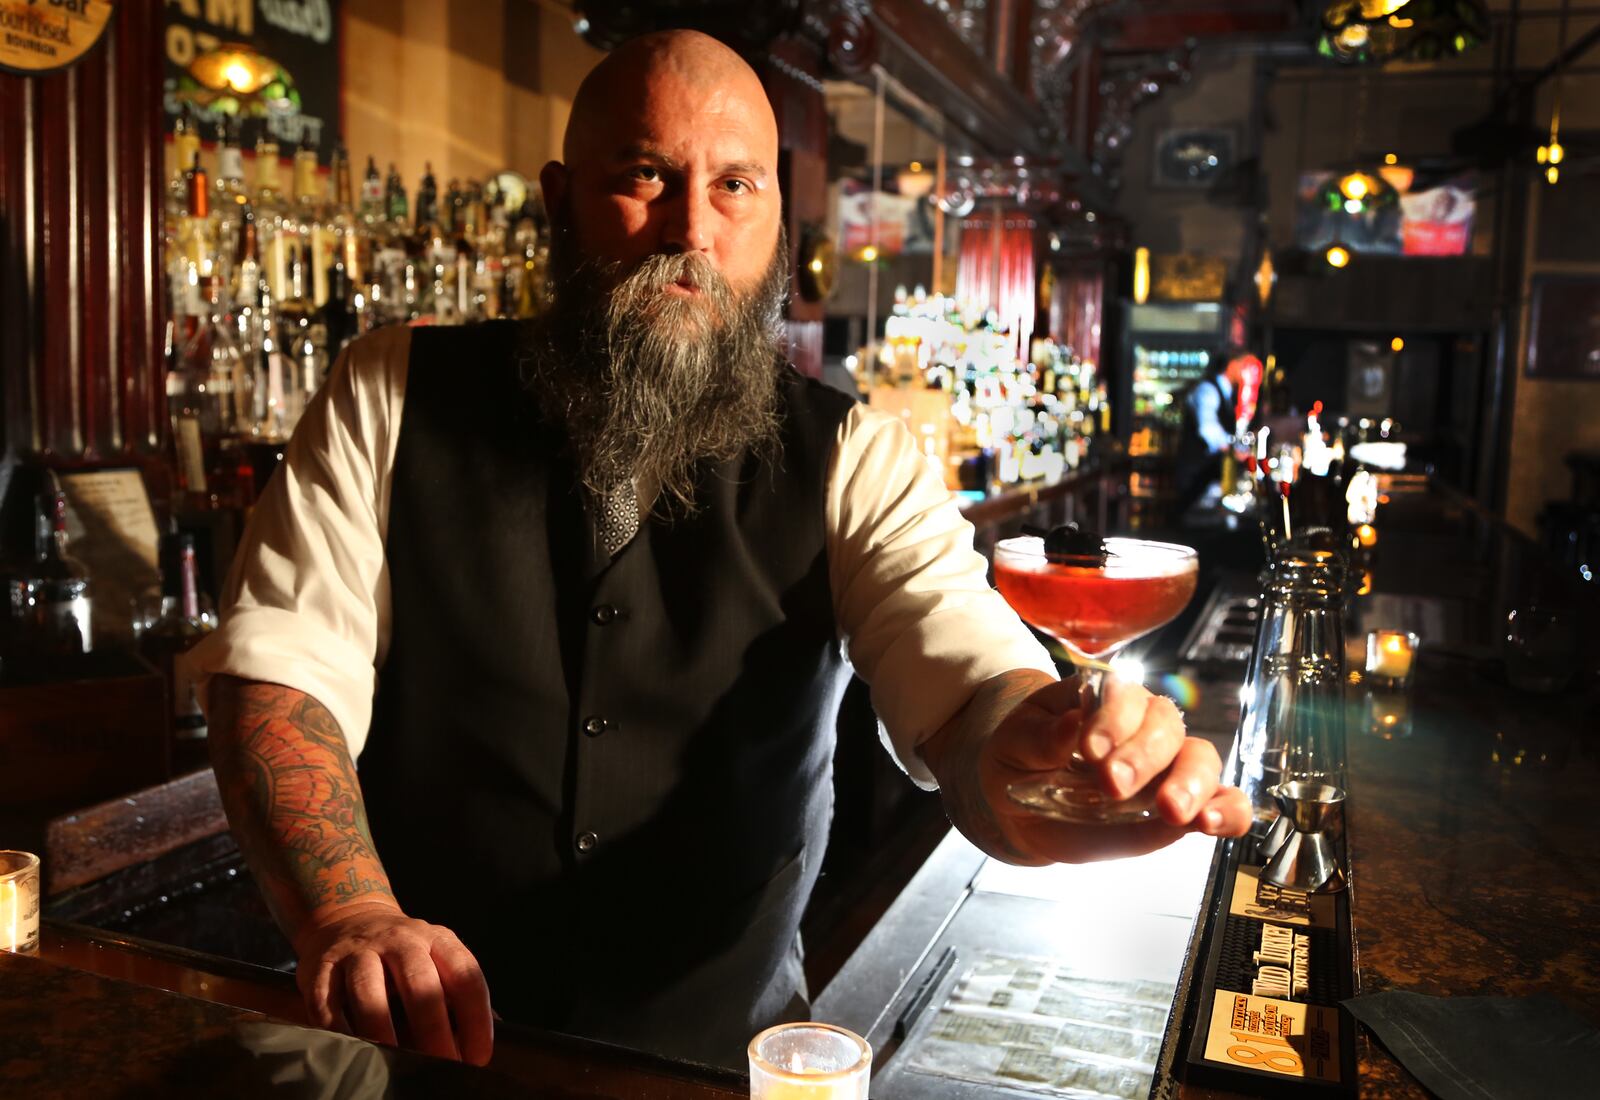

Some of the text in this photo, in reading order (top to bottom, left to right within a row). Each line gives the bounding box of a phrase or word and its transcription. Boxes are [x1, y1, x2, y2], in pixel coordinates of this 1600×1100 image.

[1253, 923, 1293, 968] TURKEY
[1293, 934, 1310, 992] BOURBON
[1252, 966, 1291, 1000] WILD
[1227, 1032, 1304, 1072] 81
